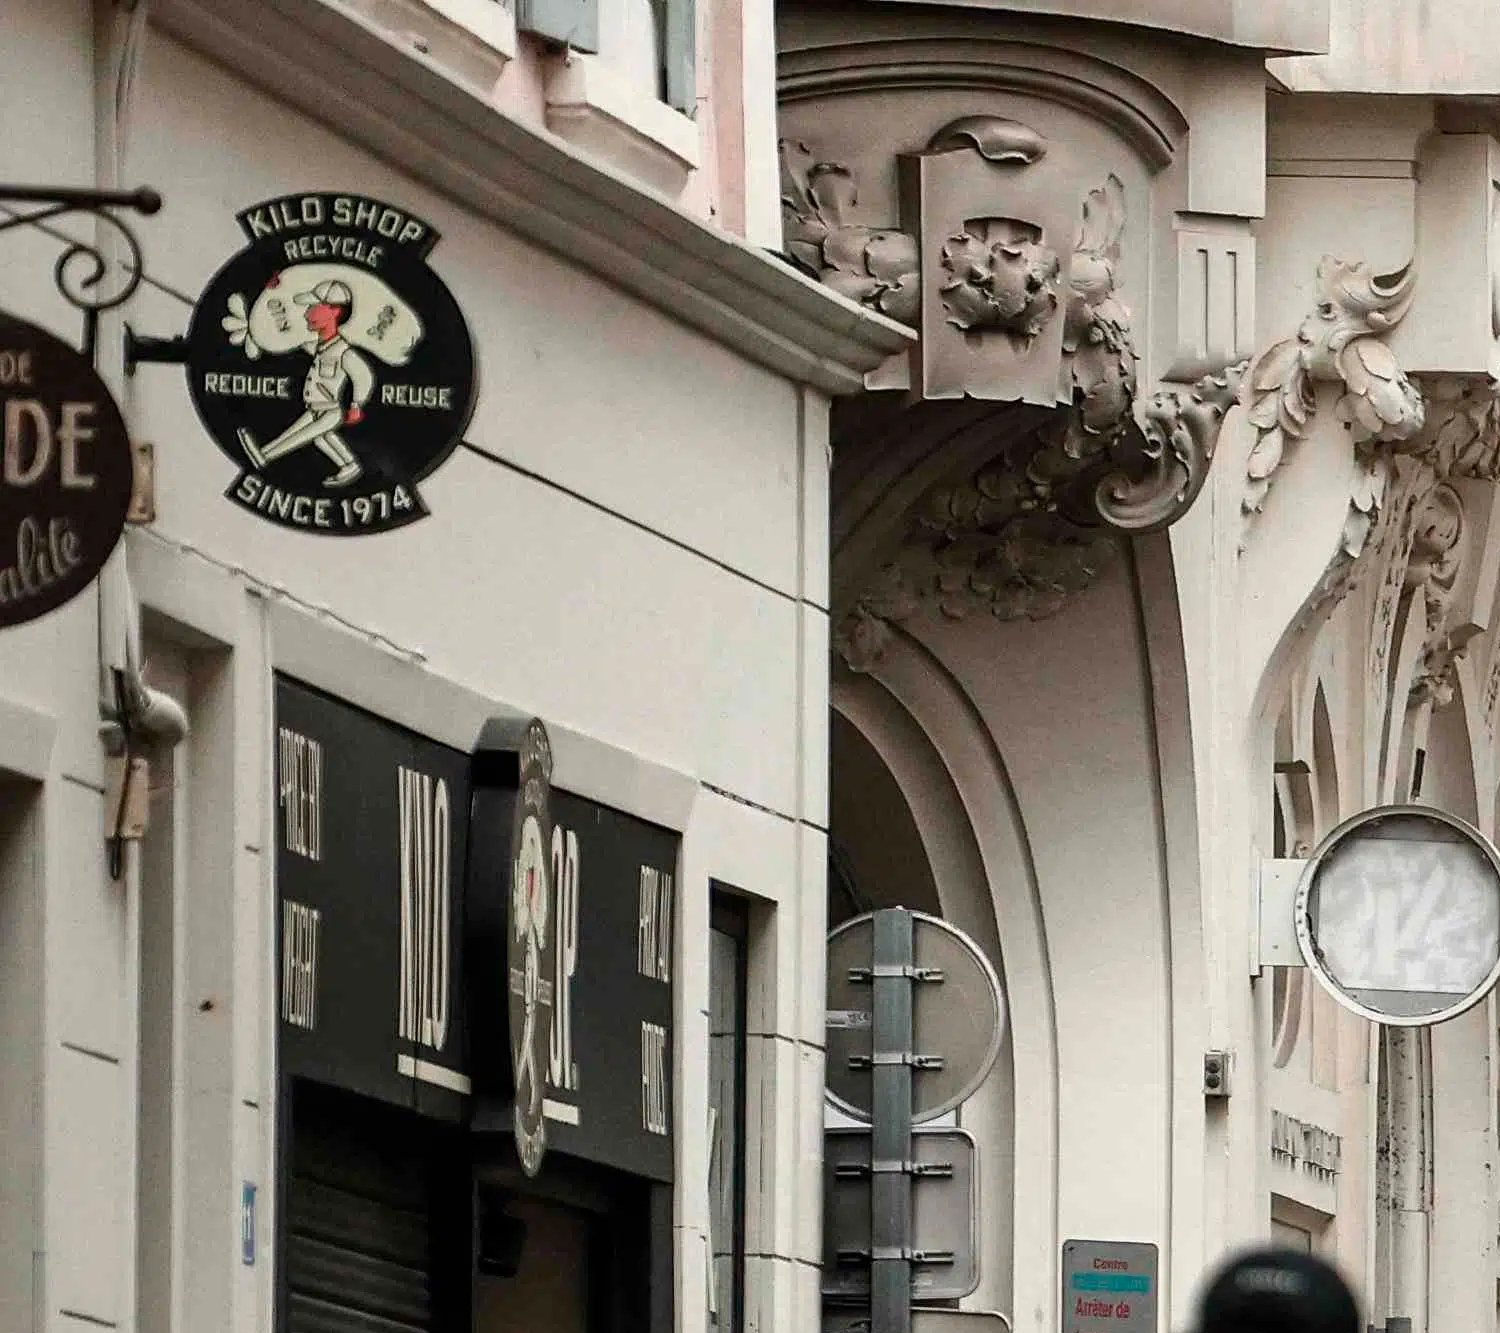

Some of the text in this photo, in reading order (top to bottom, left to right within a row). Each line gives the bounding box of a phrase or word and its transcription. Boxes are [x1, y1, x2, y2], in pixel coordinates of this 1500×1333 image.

[246, 197, 425, 244] KILO SHOP
[283, 235, 384, 268] RECYCLE
[203, 371, 290, 399] REDUCE
[381, 384, 452, 411] REUSE
[236, 477, 413, 528] SINCE 1974
